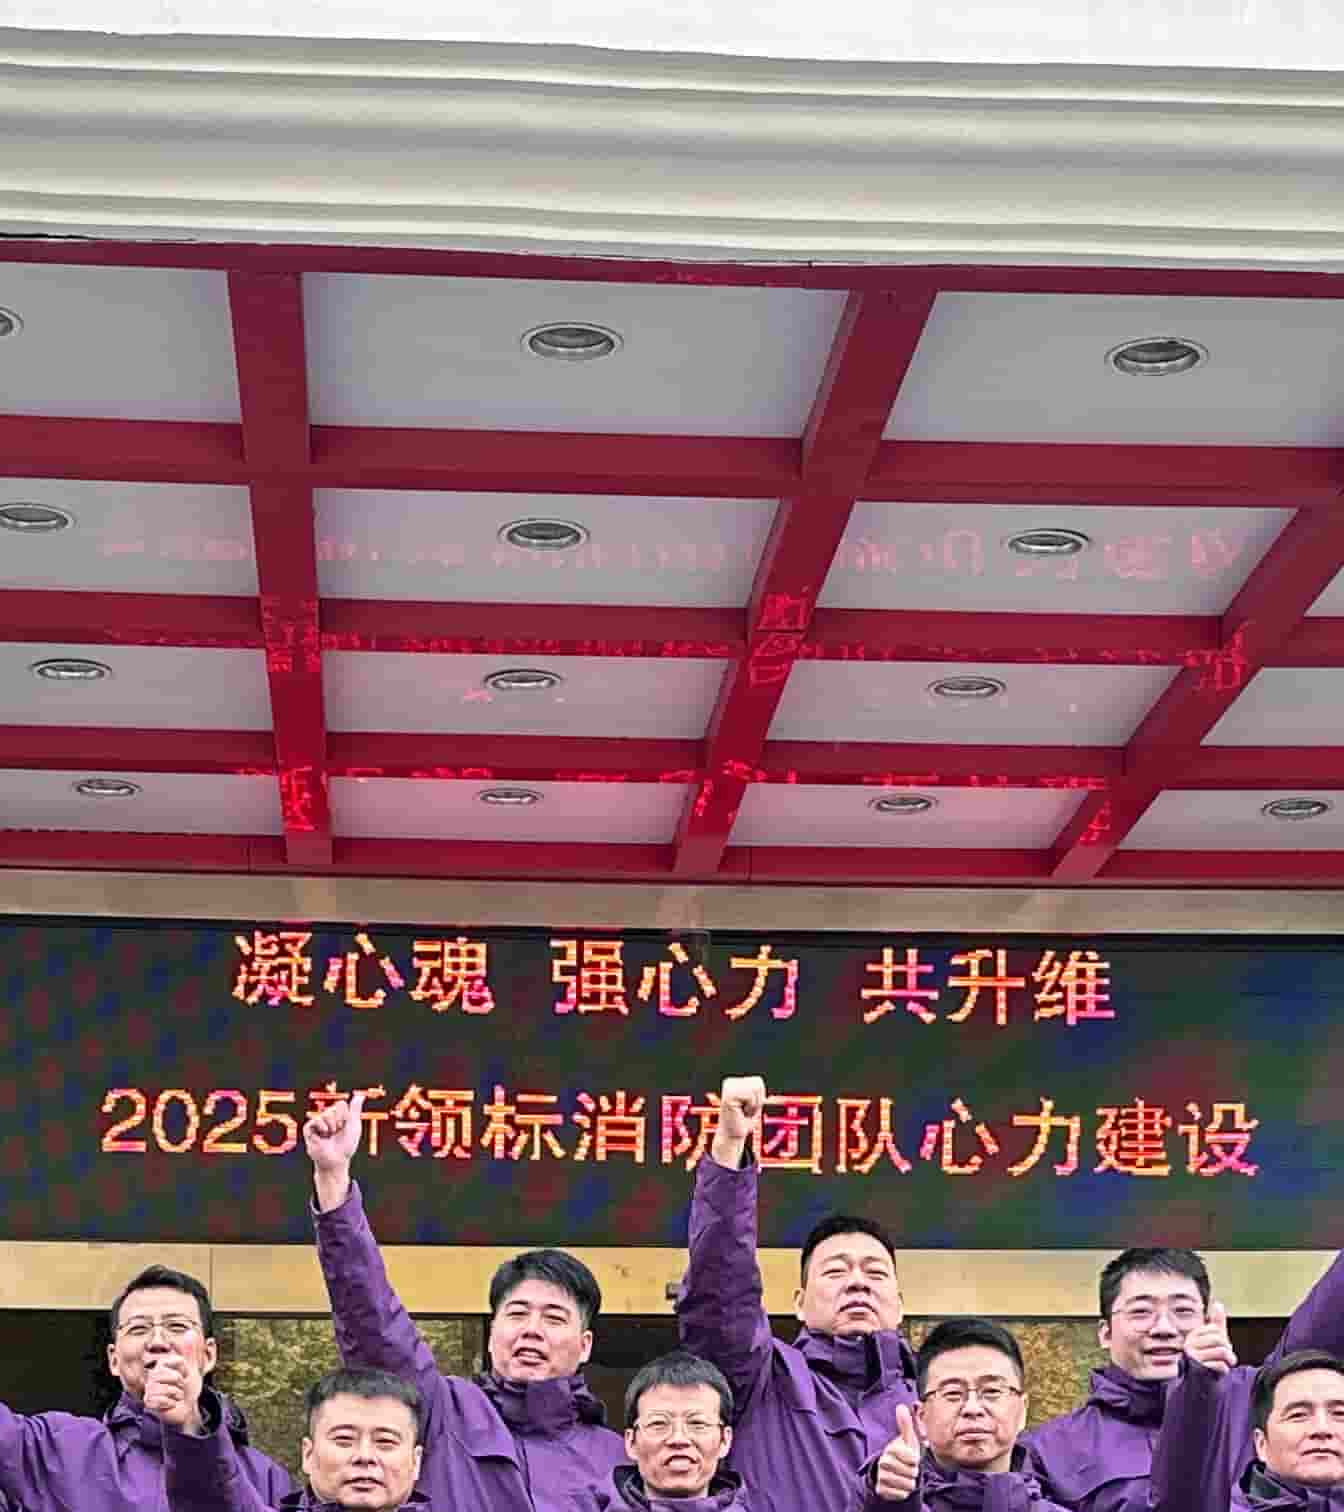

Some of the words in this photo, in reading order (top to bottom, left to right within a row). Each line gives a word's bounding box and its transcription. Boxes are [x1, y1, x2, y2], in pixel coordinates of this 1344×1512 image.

[231, 930, 495, 1013] 凝心魂
[549, 939, 800, 1018] 强心力
[860, 947, 1117, 1025] 共升维
